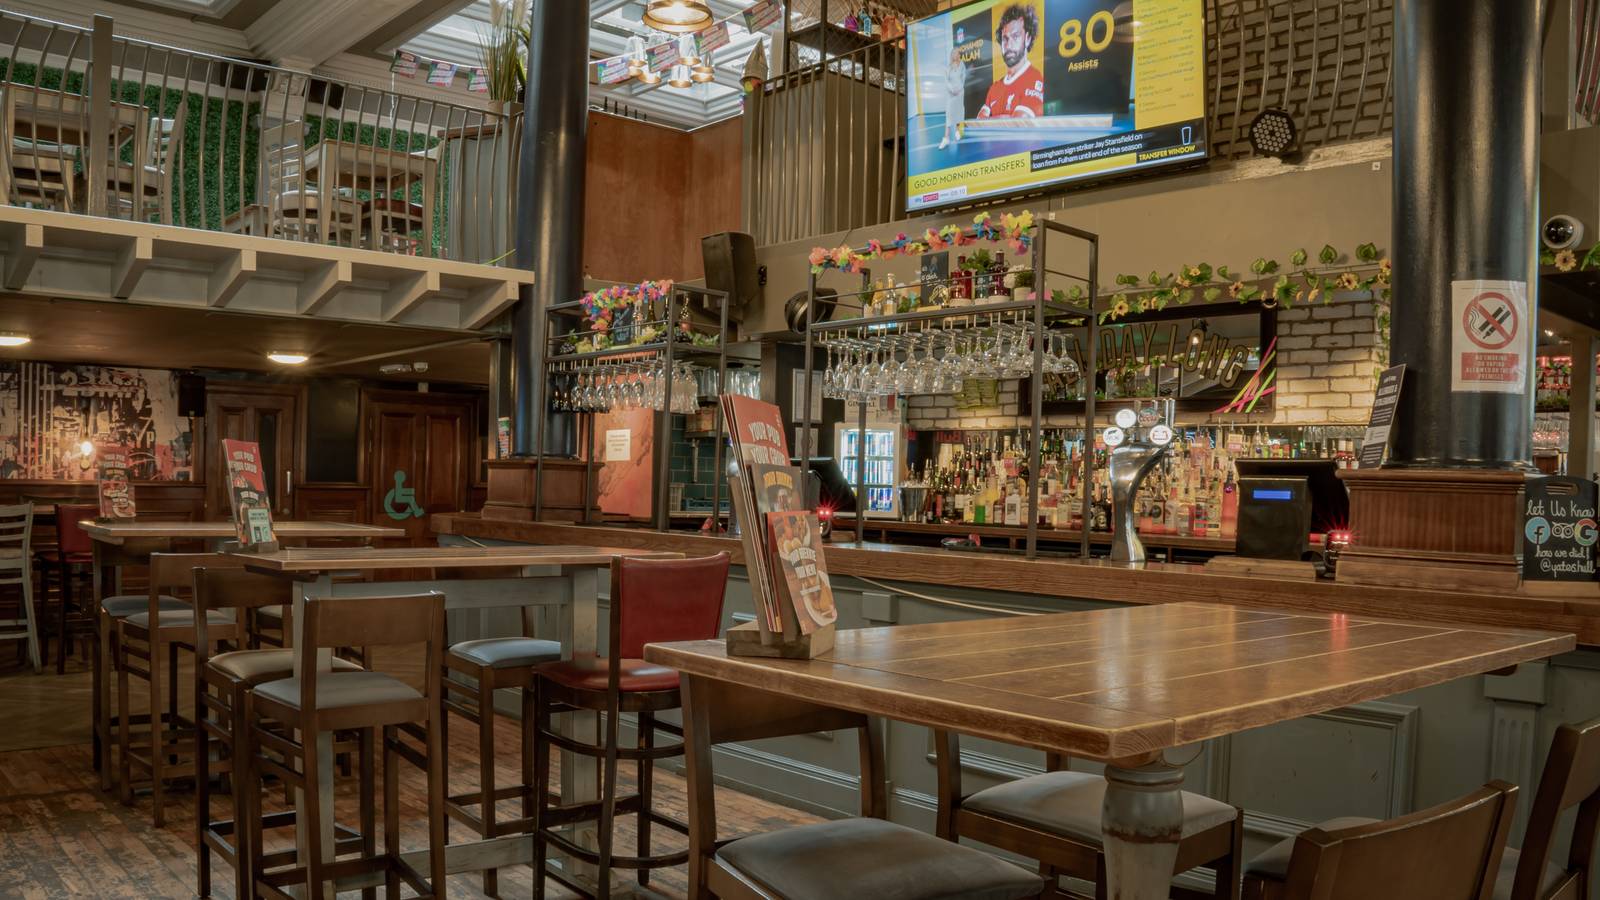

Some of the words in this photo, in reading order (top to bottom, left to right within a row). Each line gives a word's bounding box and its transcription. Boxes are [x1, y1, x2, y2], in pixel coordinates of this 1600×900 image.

[1058, 10, 1115, 58] 80
[1068, 59, 1099, 72] Assists
[1033, 147, 1064, 161] Birmingham
[1064, 146, 1076, 156] sign
[1076, 143, 1095, 152] striker
[1095, 141, 1104, 150] Jay
[1104, 135, 1134, 147] Stansfield
[1033, 161, 1044, 169] loan
[1044, 158, 1058, 167] from
[1058, 154, 1079, 164] Fulham
[1079, 151, 1091, 161] until
[1091, 149, 1103, 159] end
[1110, 145, 1121, 154] the
[1121, 143, 1143, 152] season
[1139, 149, 1168, 161] TRANSFER
[1168, 145, 1197, 156] WINDOW
[914, 178, 938, 189] GOOD
[940, 168, 979, 183] MORNING
[980, 159, 1025, 175] TRANSFERS
[1100, 322, 1158, 370] DAY
[1166, 324, 1249, 388] LONG
[1551, 500, 1566, 517] Us
[1535, 545, 1552, 558] how
[1554, 550, 1567, 558] we
[1540, 558, 1596, 578] @yateshull
